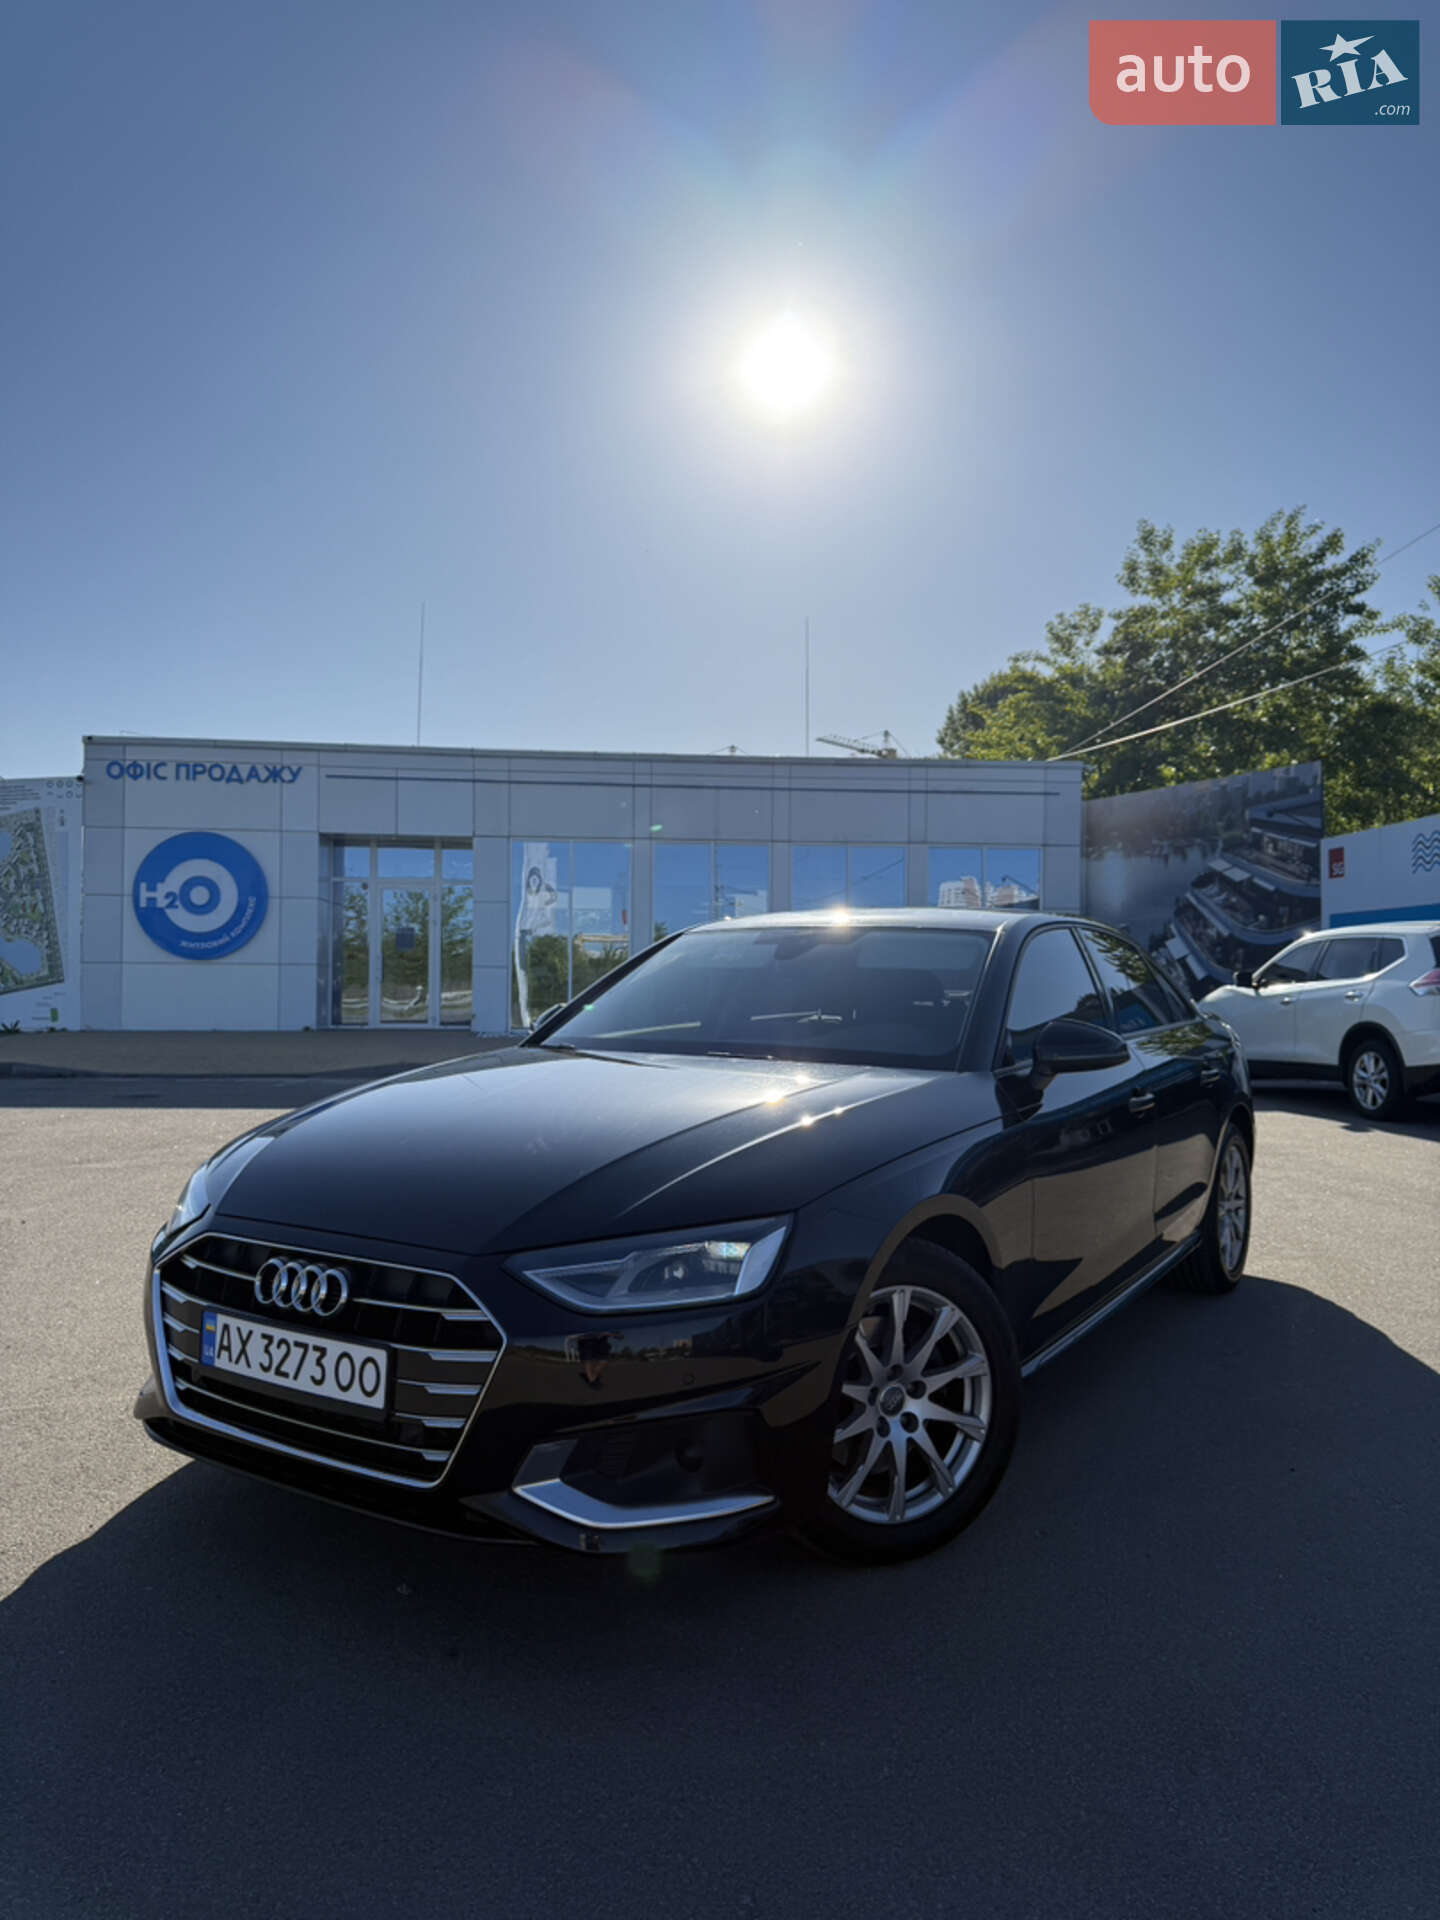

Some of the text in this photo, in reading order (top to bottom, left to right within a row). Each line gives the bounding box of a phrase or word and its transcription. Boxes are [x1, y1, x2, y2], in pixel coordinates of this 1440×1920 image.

[105, 760, 303, 785] ОФІС ПРОДАЖУ
[217, 1323, 254, 1369] AX
[259, 1331, 327, 1387] 3273
